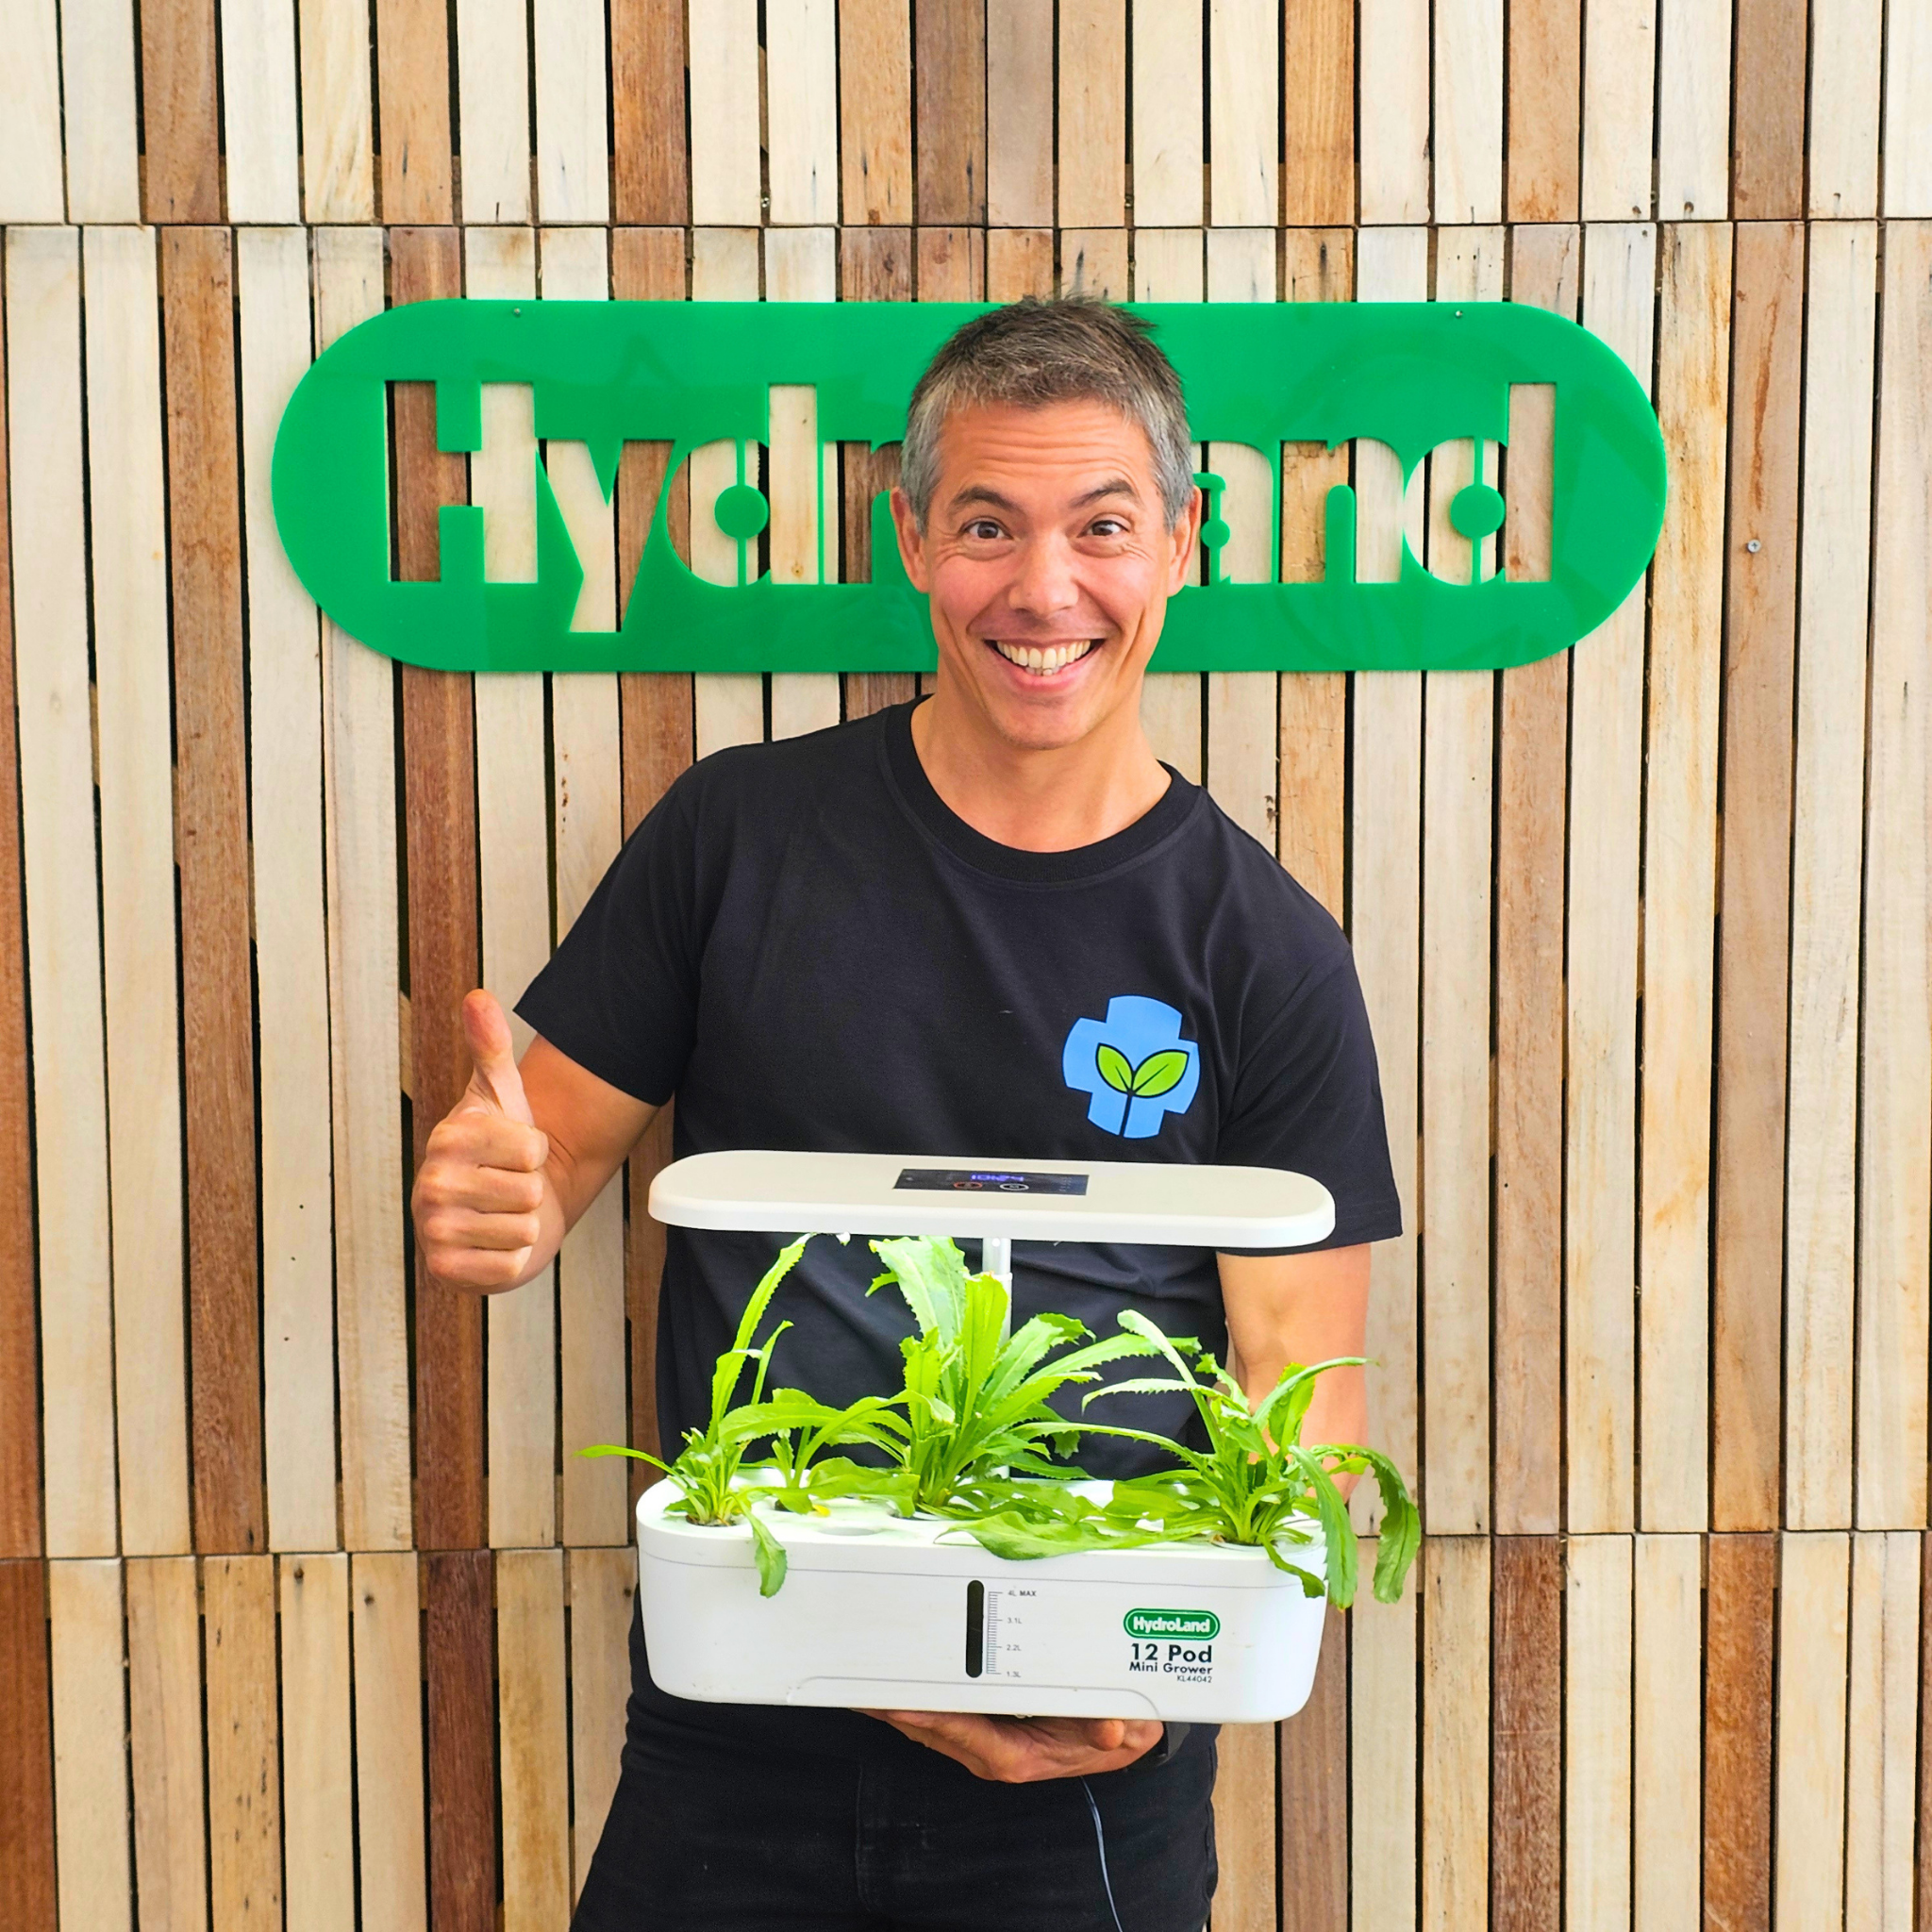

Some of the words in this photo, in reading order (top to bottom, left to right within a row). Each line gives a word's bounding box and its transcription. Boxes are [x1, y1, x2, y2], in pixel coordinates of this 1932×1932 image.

[1133, 1616, 1210, 1634] HydroLand
[1131, 1642, 1158, 1661] 12
[1168, 1644, 1212, 1663] Pod
[1129, 1661, 1158, 1673] Mini
[1162, 1662, 1213, 1674] Grower
[1176, 1674, 1213, 1684] KL44042
